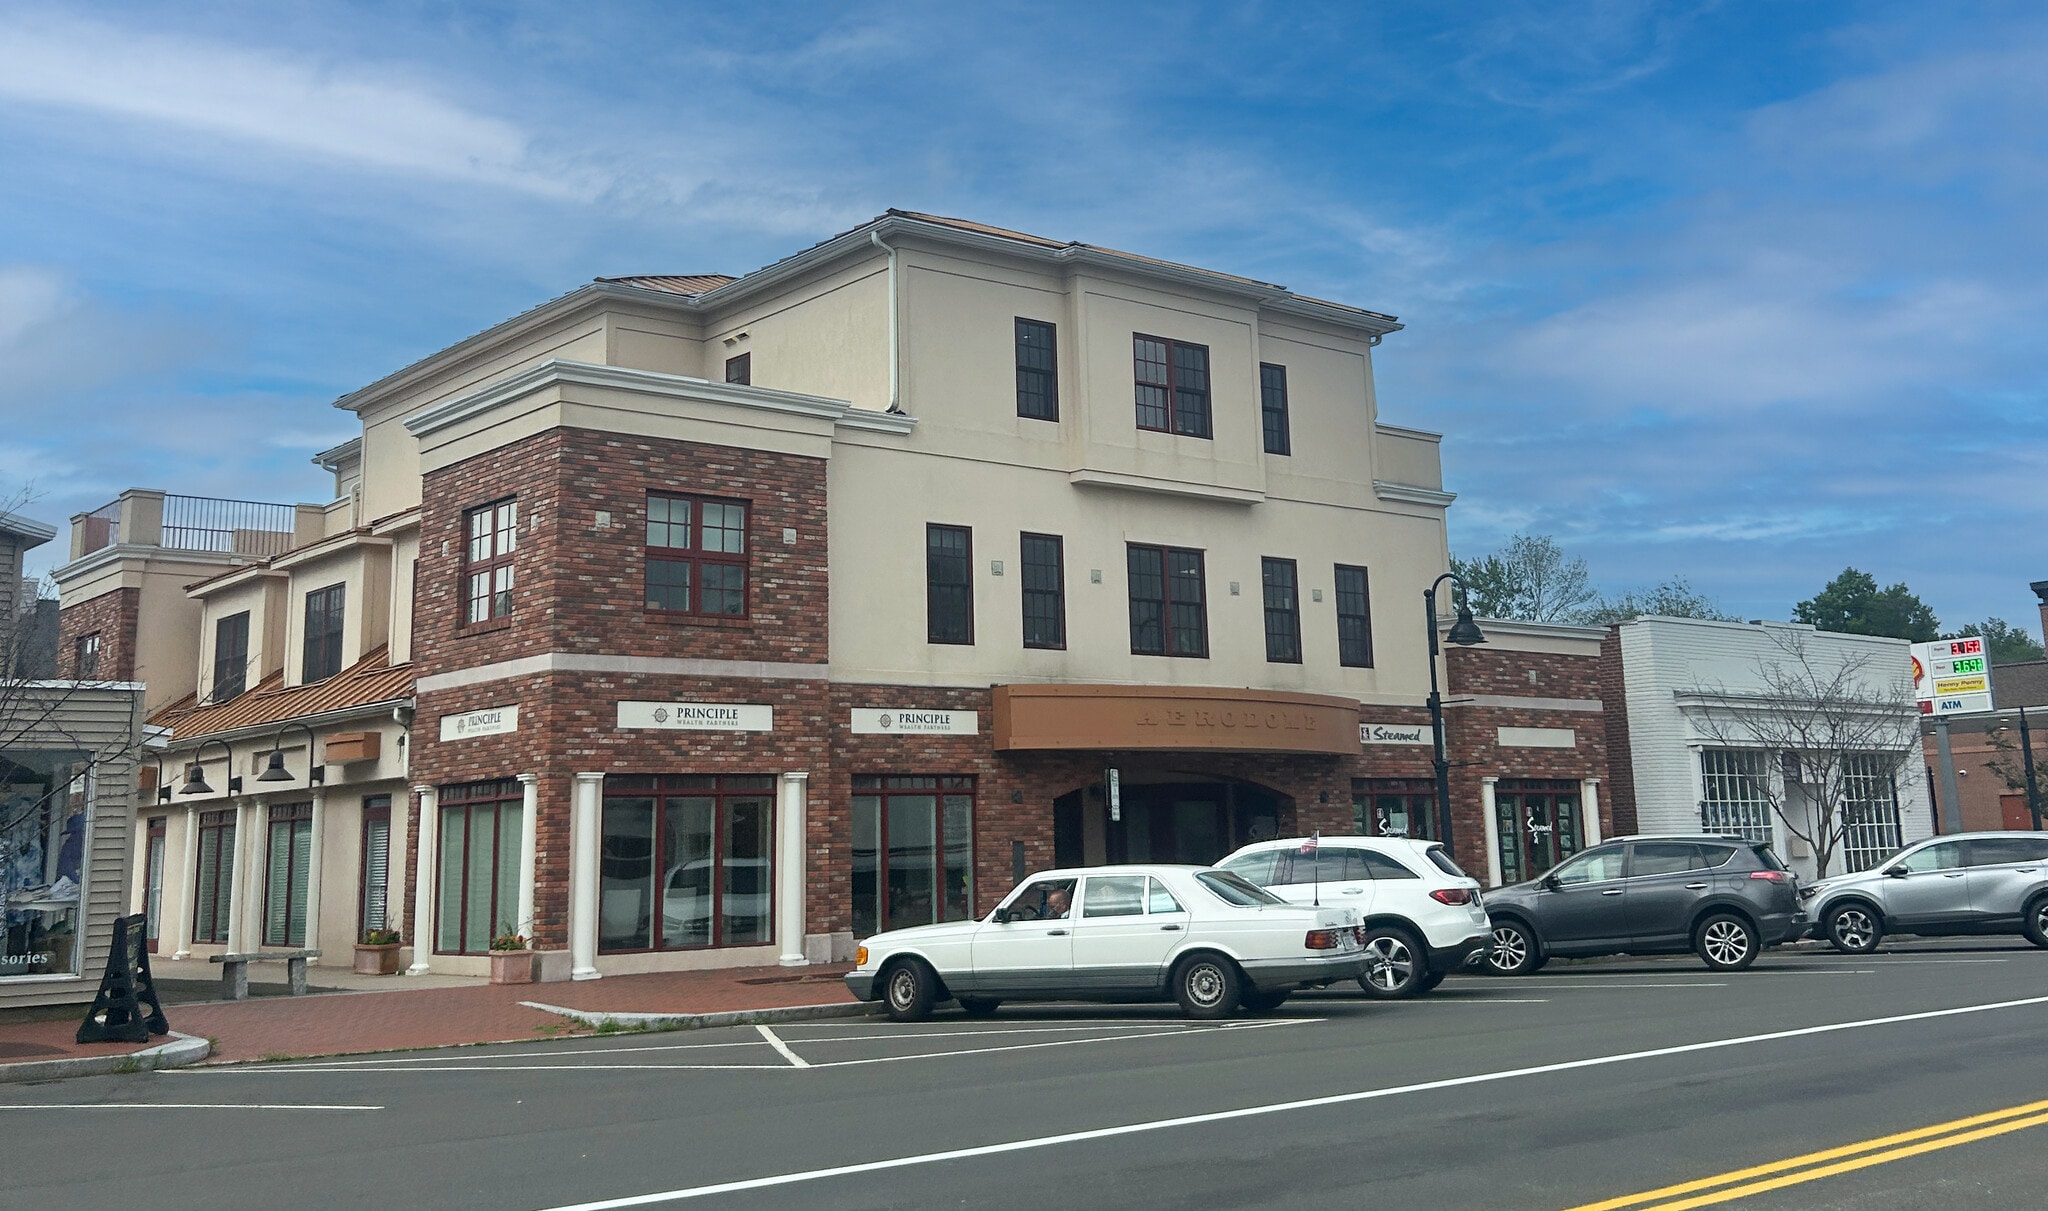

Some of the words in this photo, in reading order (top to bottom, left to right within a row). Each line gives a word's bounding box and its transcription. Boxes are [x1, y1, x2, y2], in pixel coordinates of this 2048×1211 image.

[1941, 700, 1962, 710] ATM
[468, 712, 501, 727] PRINCIPLE
[677, 707, 739, 719] PRINCIPLE
[899, 713, 950, 724] PRINCIPLE
[1373, 726, 1421, 742] Steamed
[0, 951, 48, 965] sories
